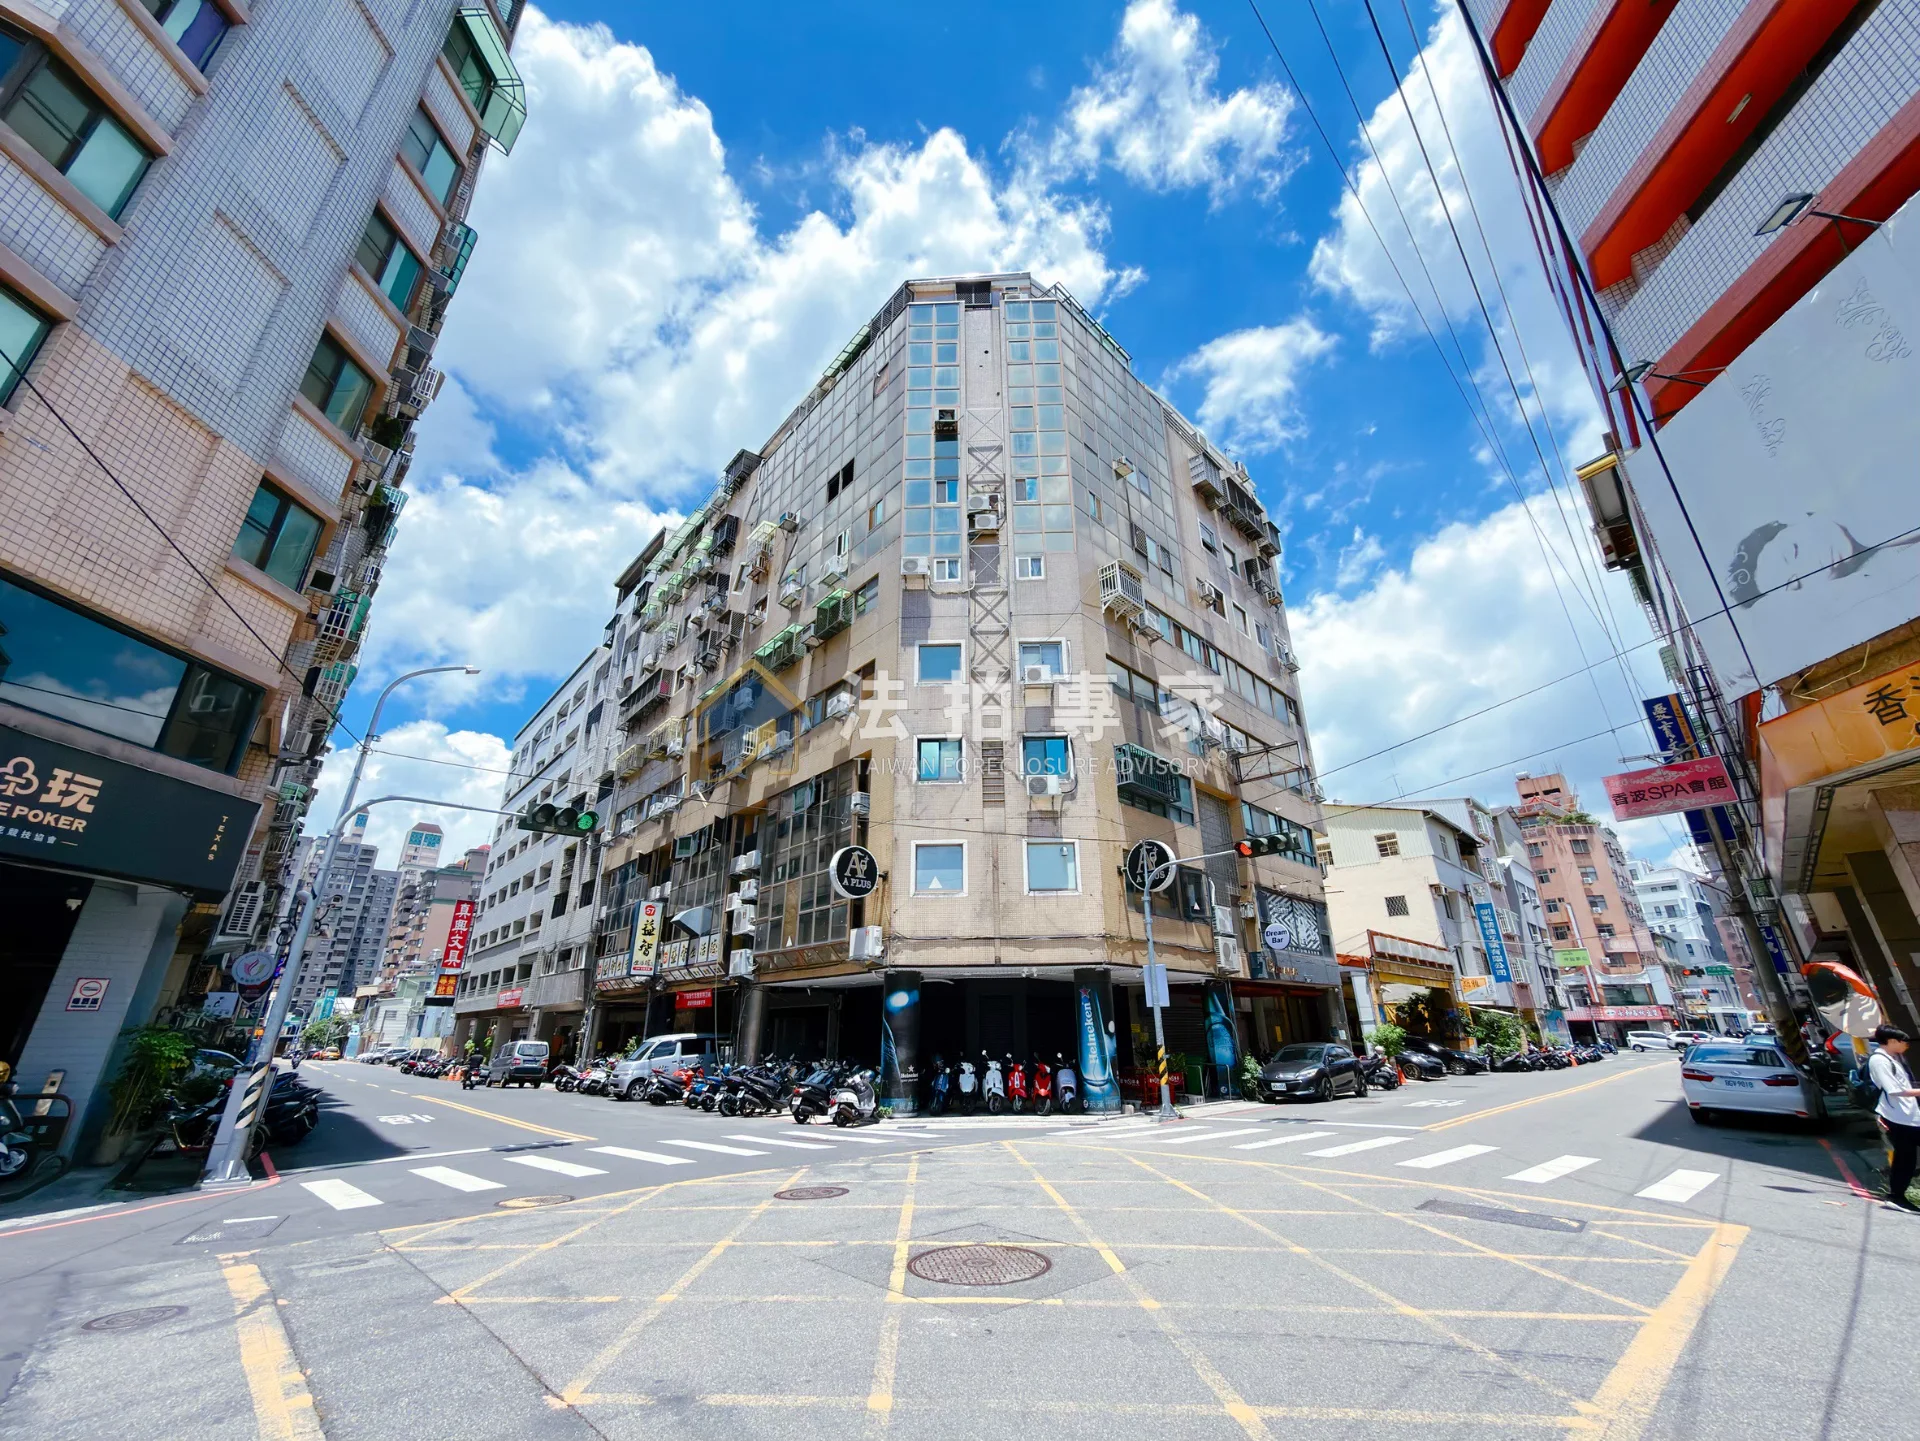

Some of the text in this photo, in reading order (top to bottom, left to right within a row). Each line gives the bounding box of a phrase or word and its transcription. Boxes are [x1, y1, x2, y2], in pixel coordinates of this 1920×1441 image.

[39, 767, 103, 813] 玩
[1612, 776, 1728, 806] 香波SPA會館
[11, 805, 88, 833] POKER
[207, 815, 229, 861] TEXAS
[842, 877, 872, 889] A PLUS
[443, 902, 471, 967] 真興文具
[638, 919, 656, 957] 益智
[1265, 929, 1288, 937] Dream
[1084, 1002, 1099, 1065] Heineken
